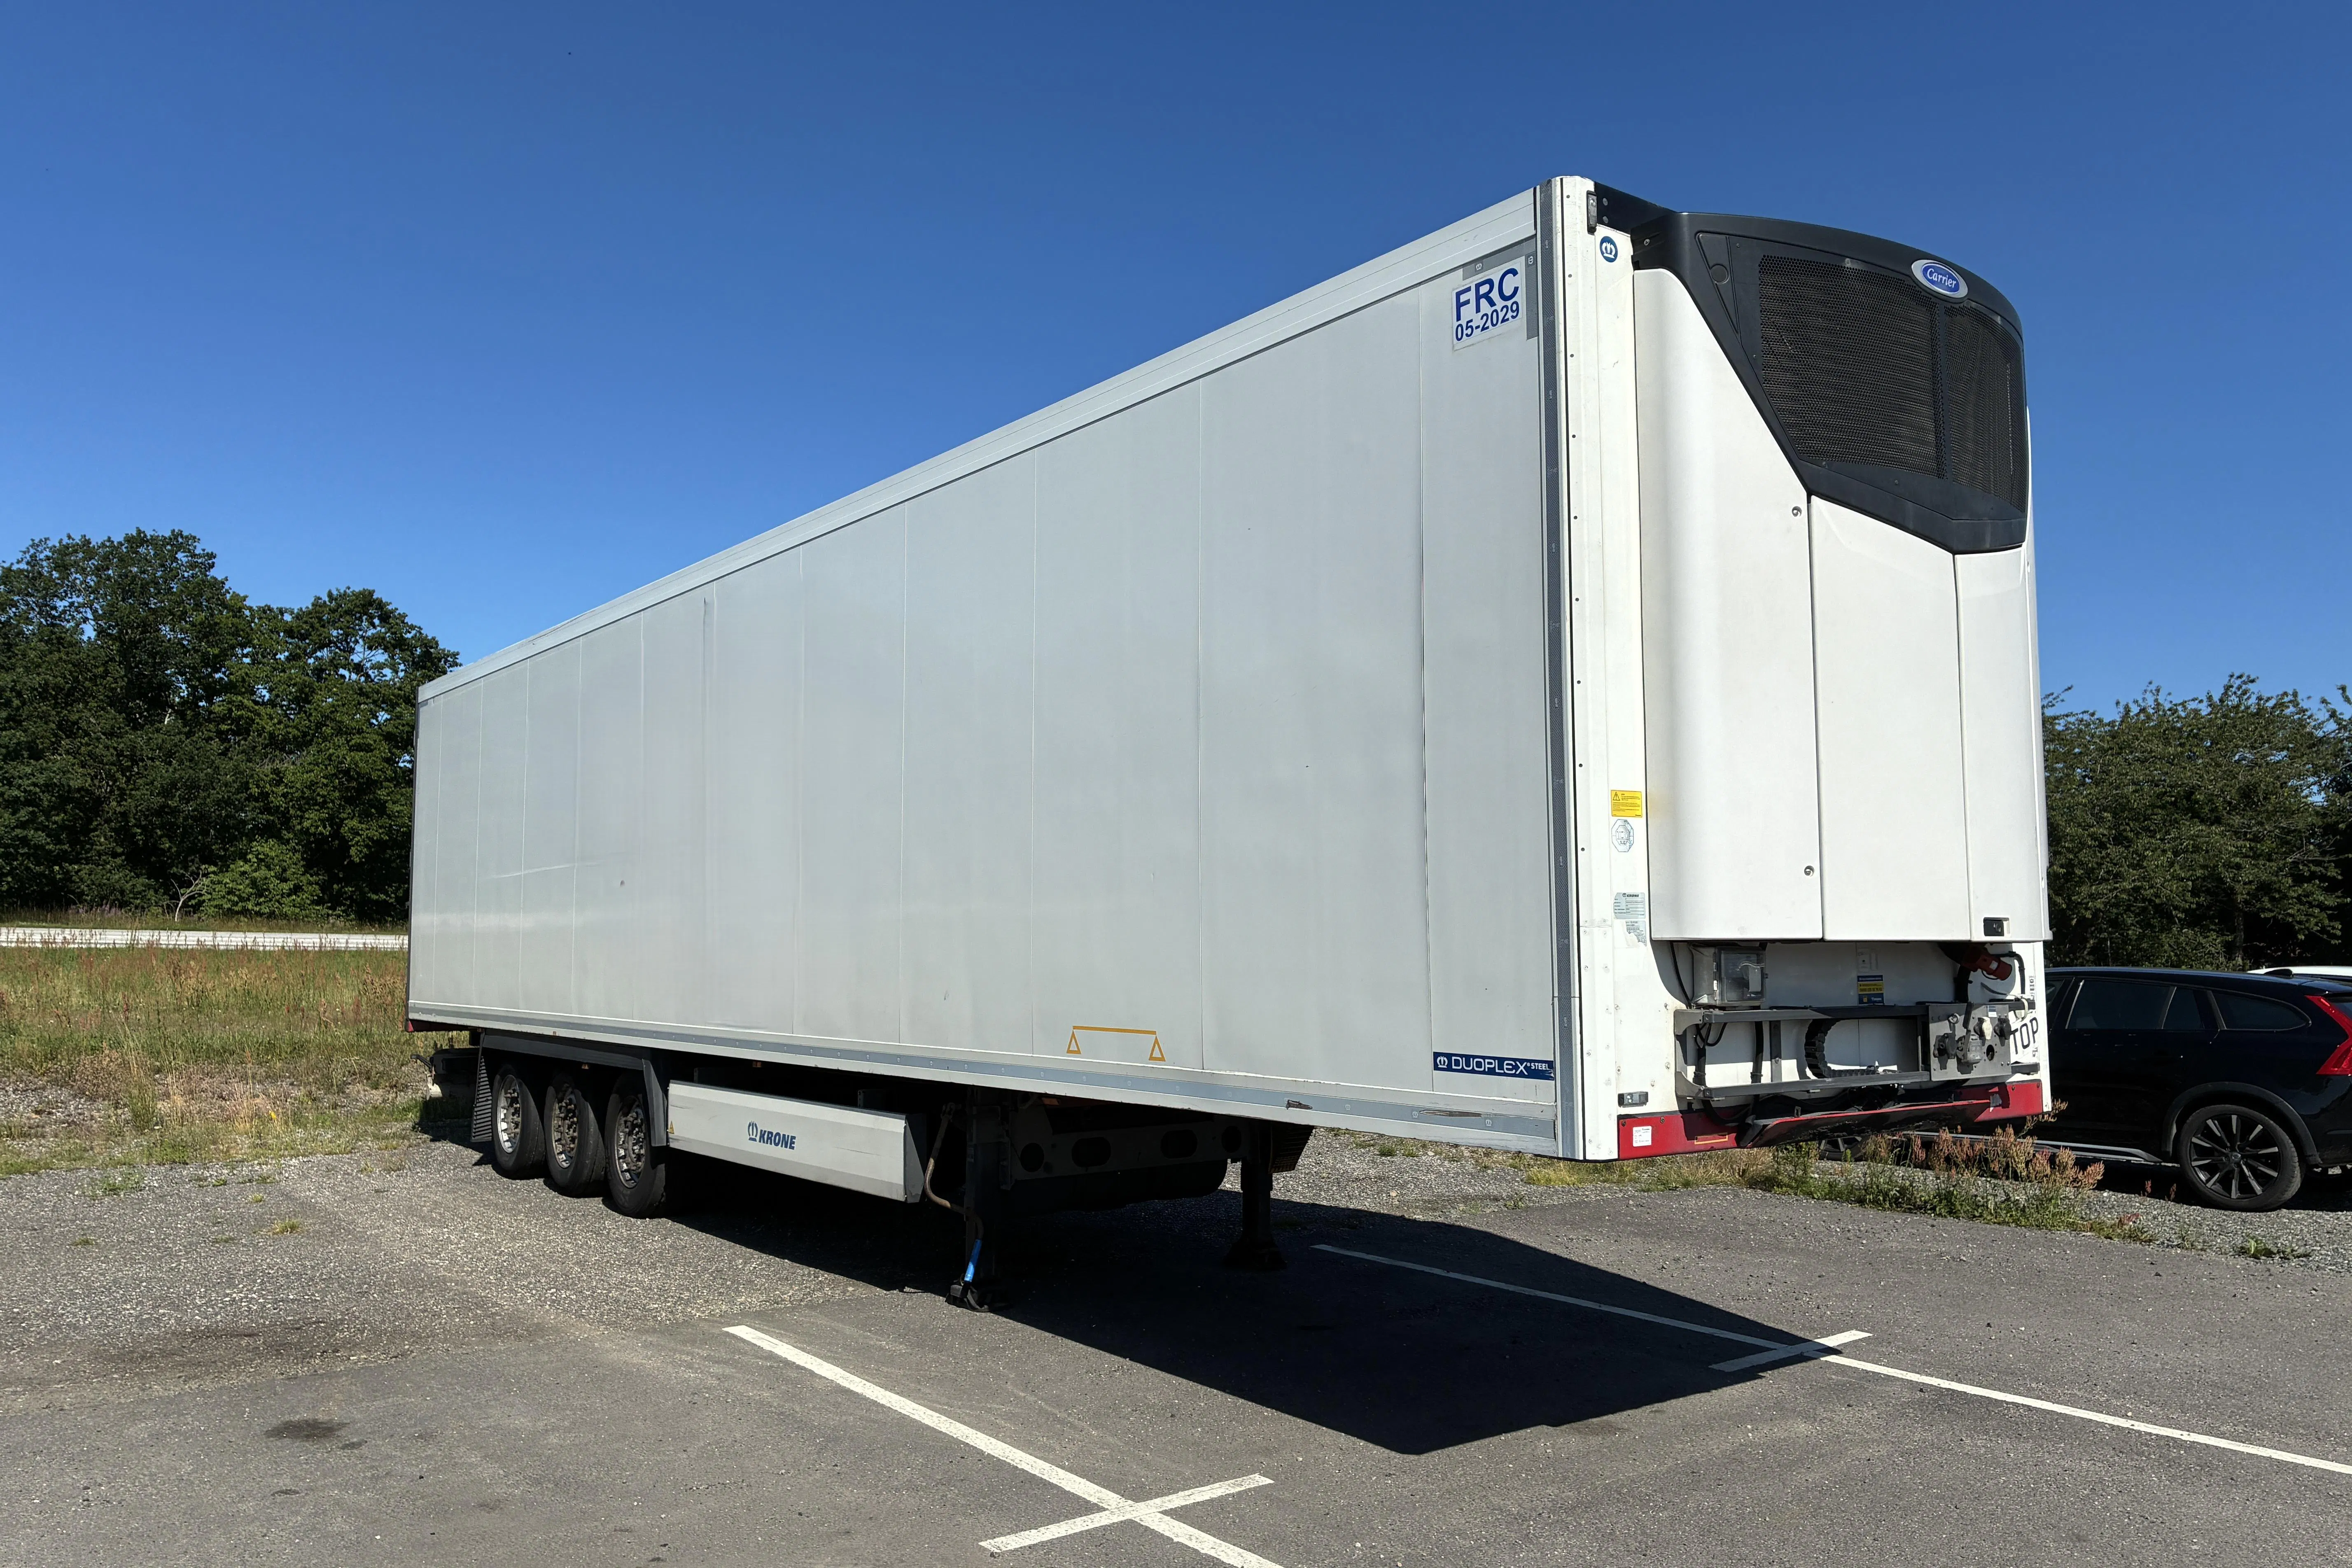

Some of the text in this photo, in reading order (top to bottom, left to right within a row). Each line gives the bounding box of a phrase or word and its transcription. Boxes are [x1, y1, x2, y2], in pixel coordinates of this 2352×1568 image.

[1927, 268, 1956, 288] Carrier
[1455, 268, 1519, 322] FRC
[1455, 301, 1519, 341] 05-2029
[758, 1129, 796, 1150] KRONE
